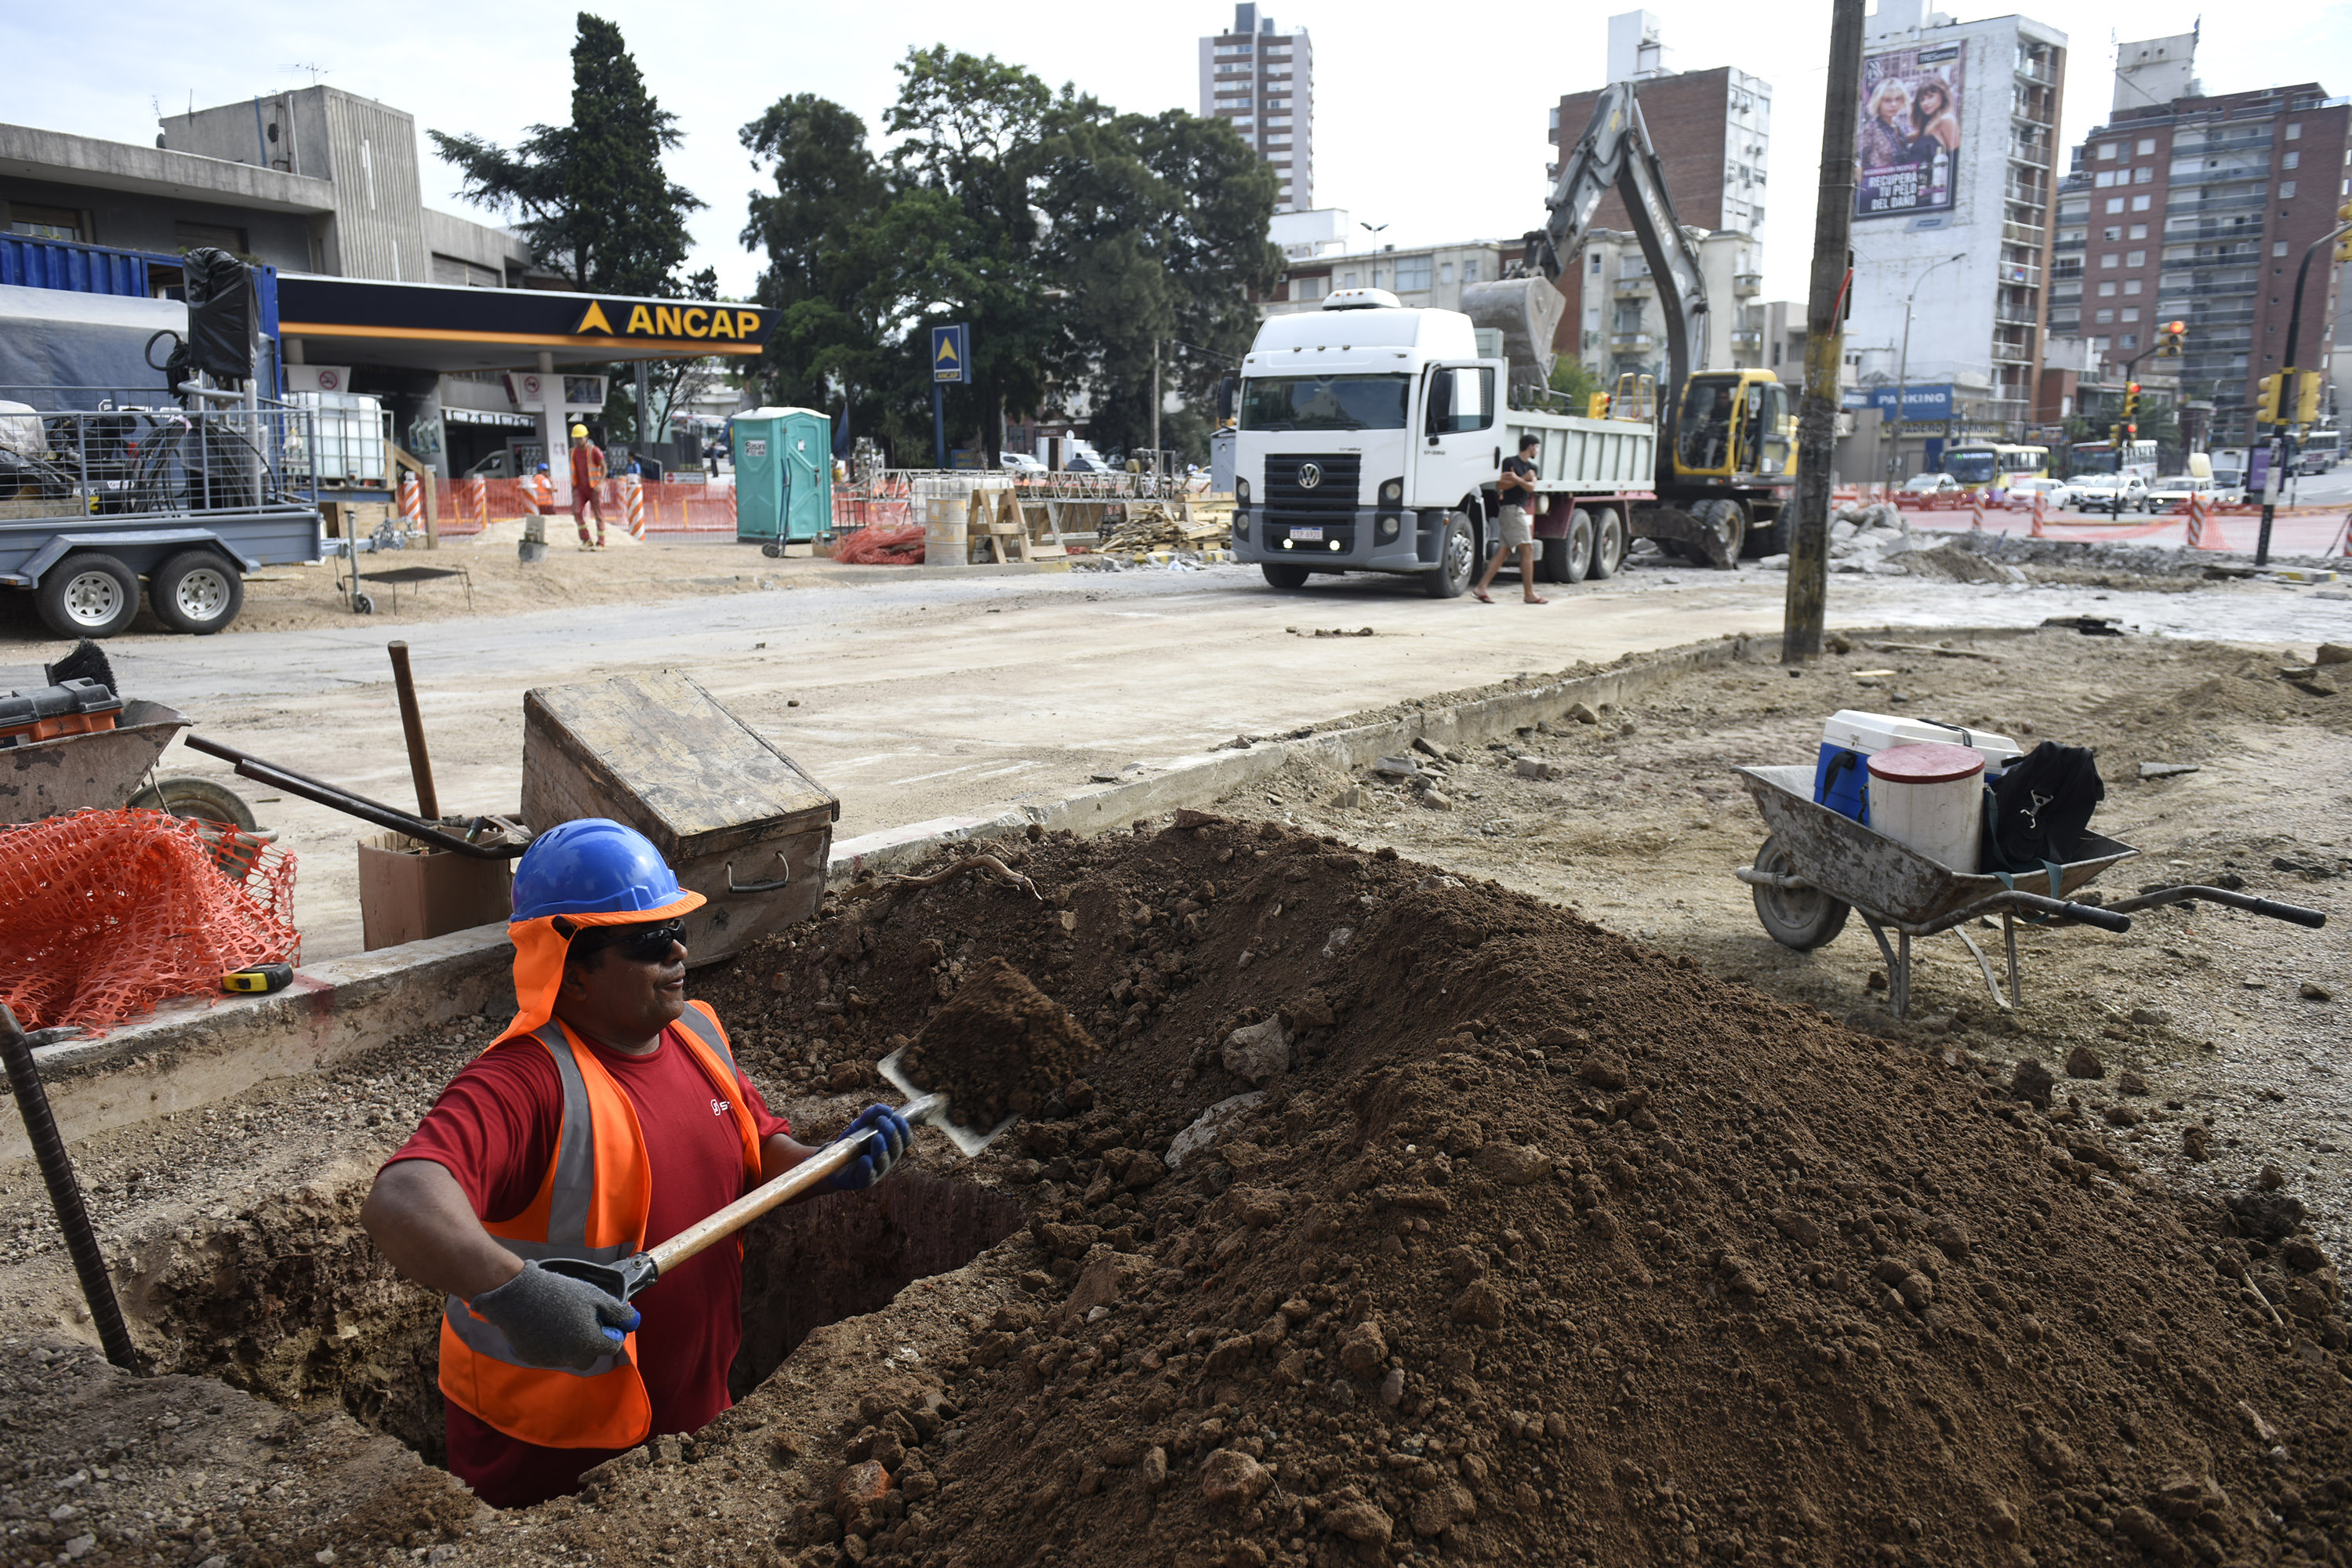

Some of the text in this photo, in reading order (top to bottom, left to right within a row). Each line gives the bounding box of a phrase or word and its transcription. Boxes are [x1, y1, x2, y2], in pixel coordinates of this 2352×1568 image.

[1892, 182, 1917, 196] PELO
[1871, 198, 1889, 210] DEL
[626, 304, 760, 339] ANCAP
